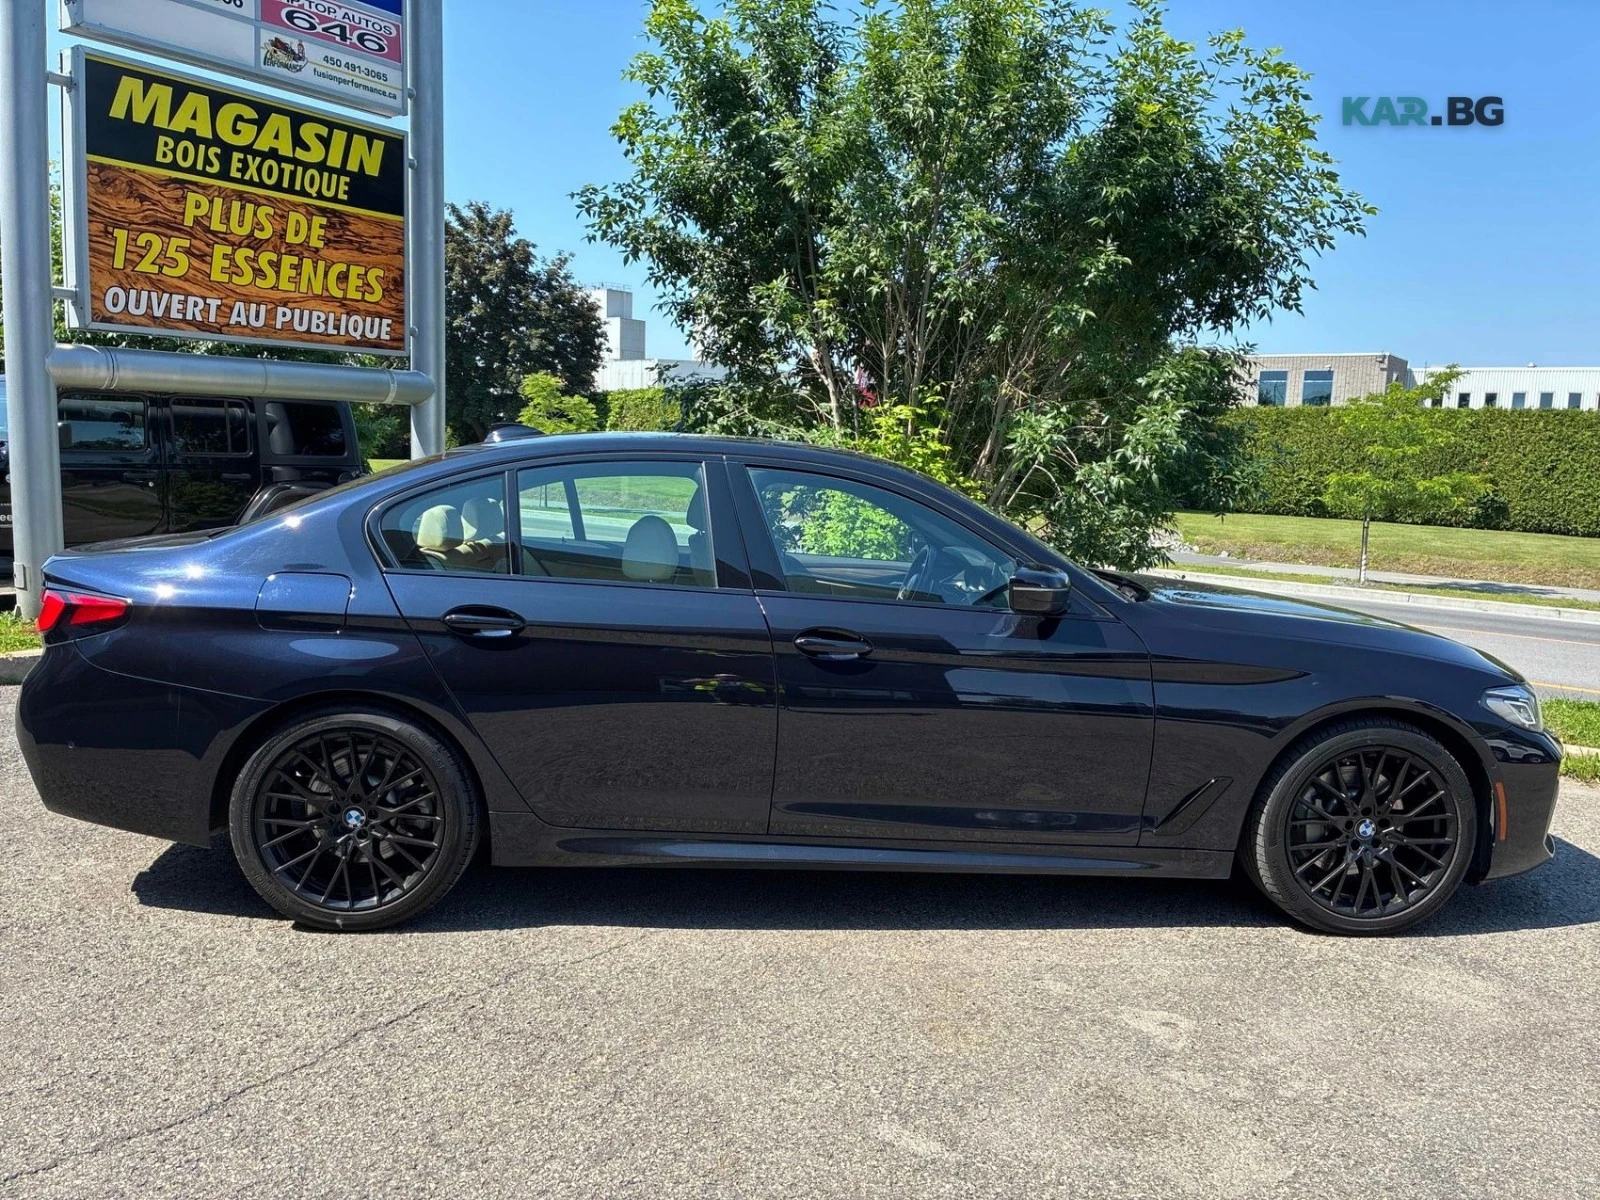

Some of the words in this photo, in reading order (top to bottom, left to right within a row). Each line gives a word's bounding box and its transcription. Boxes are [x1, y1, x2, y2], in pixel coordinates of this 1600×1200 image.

[285, 9, 387, 53] 646
[342, 12, 393, 36] AUTOS
[313, 67, 397, 100] fusionperformance.ca
[323, 55, 342, 67] 450
[344, 62, 388, 82] 491-3065
[108, 75, 386, 178] MAGASIN
[155, 136, 221, 175] BOIS
[229, 156, 351, 201] EXOTIQUE
[183, 191, 275, 239] PLUS
[285, 213, 327, 249] DE
[110, 228, 191, 278] 125
[210, 245, 385, 303] ESSENCES
[104, 286, 222, 324] OUVERT
[228, 300, 266, 329] AU
[275, 307, 392, 341] PUBLIQUE
